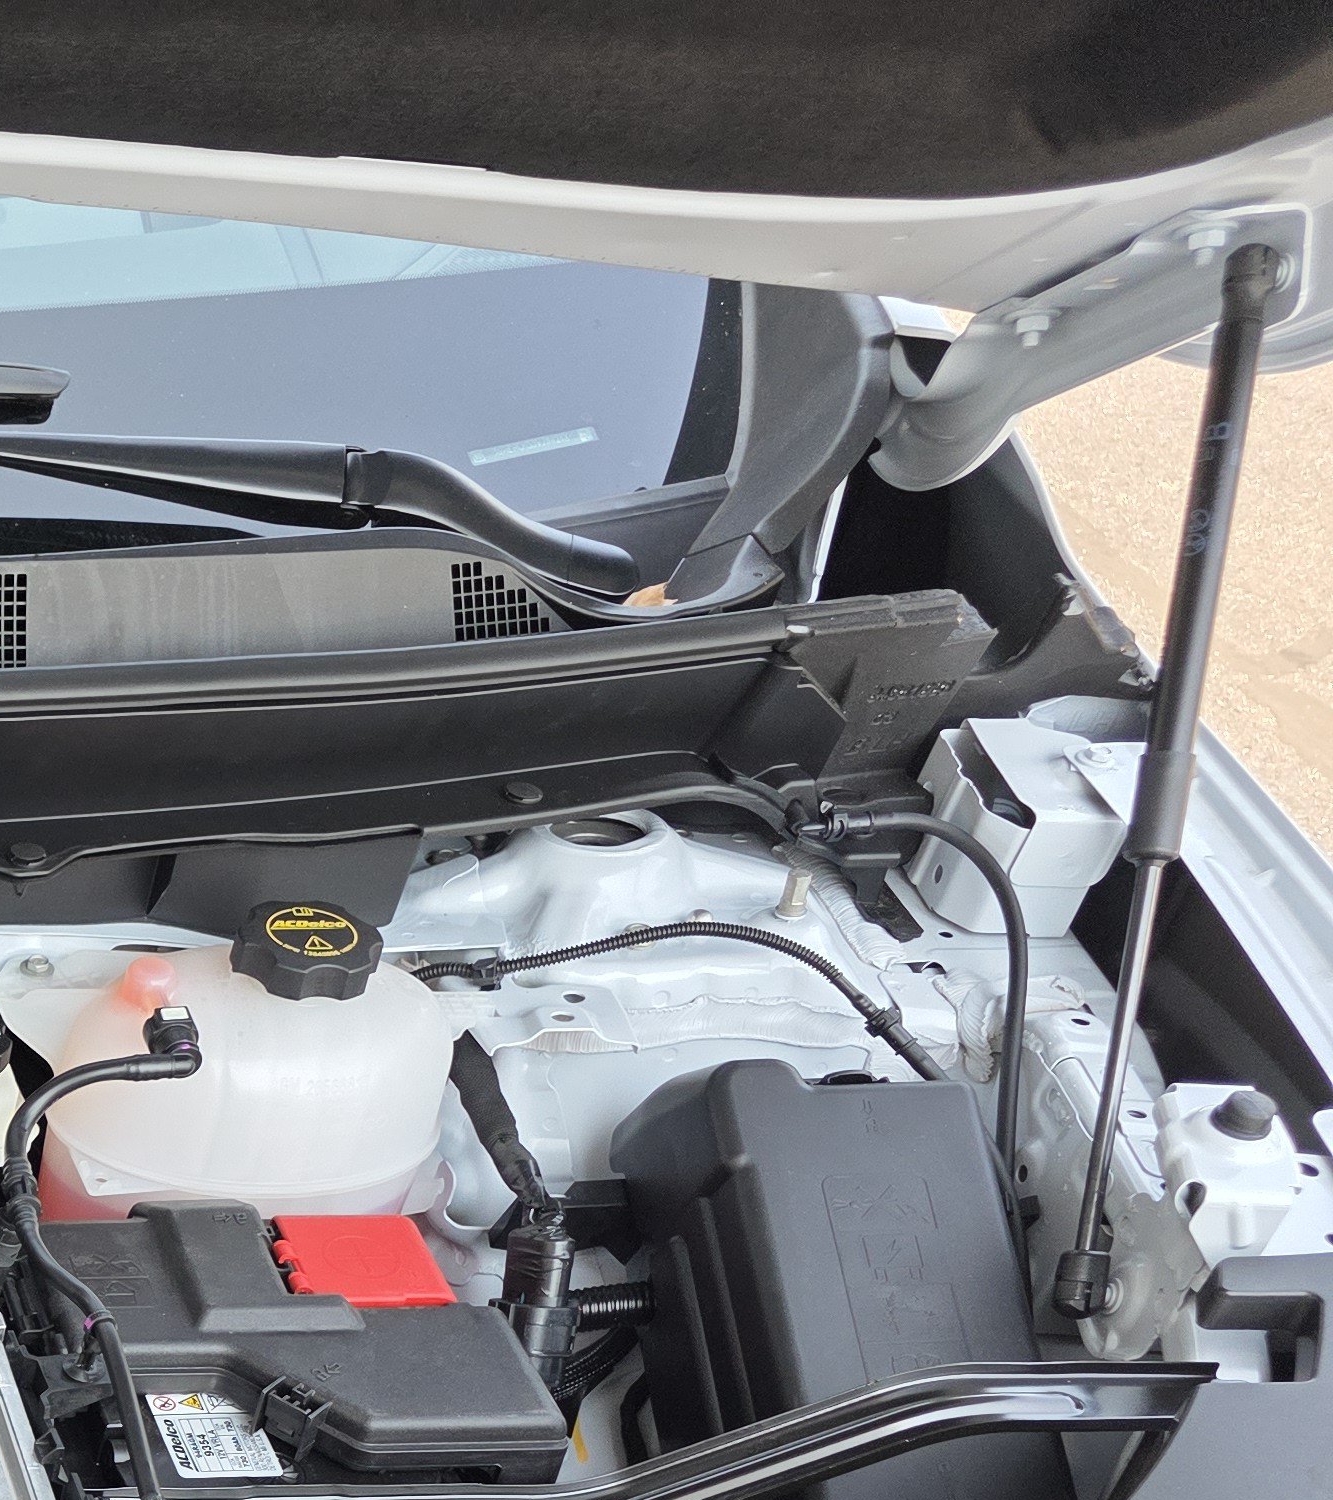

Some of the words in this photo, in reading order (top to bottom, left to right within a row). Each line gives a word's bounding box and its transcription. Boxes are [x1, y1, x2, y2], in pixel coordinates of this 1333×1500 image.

[270, 919, 347, 929] ACDelco
[164, 1420, 193, 1470] ACDelco
[197, 1434, 214, 1456] 9354
[208, 1430, 220, 1447] VRLA
[215, 1449, 226, 1459] 12V
